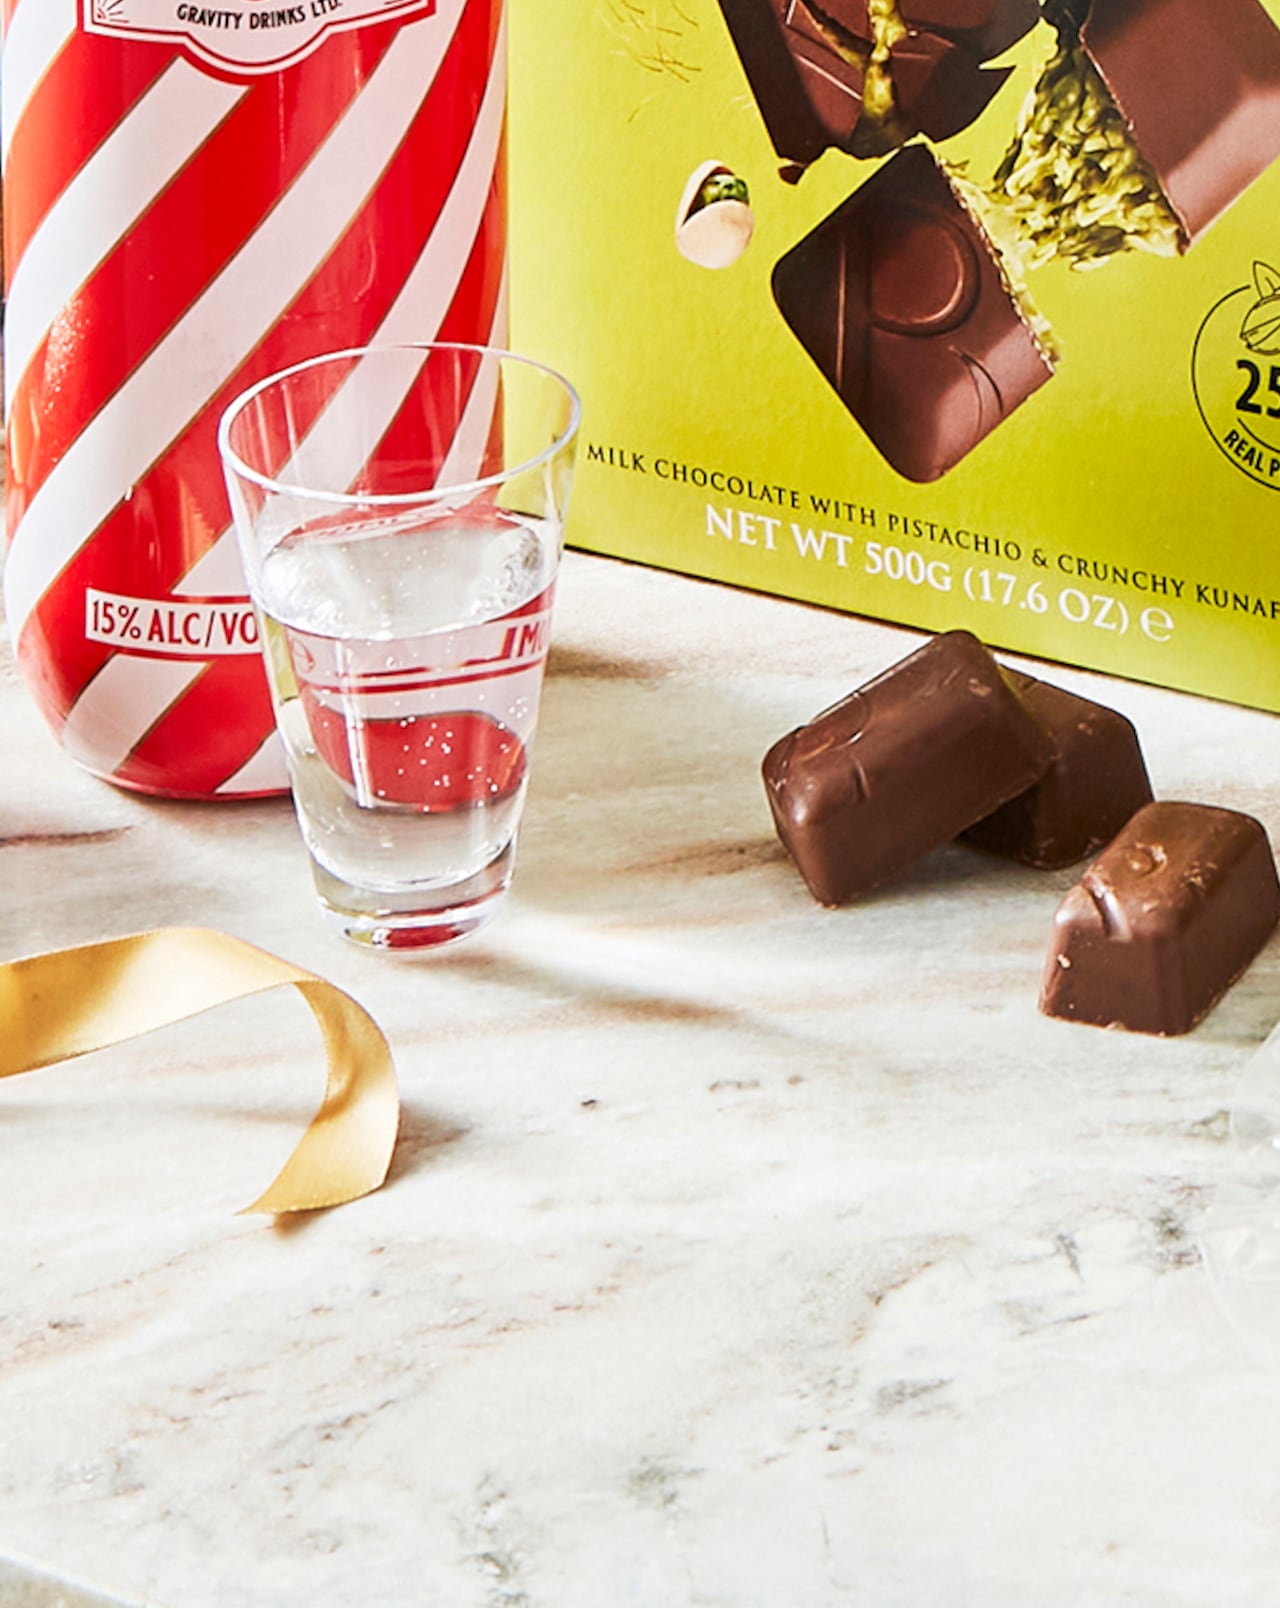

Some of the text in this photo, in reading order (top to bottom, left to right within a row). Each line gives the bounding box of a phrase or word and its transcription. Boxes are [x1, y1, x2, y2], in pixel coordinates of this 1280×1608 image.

[177, 2, 243, 30] GRAVITY
[250, 3, 306, 30] DRINKS
[1223, 429, 1265, 473] REAL
[586, 443, 647, 475] MILK
[653, 457, 802, 510] CHOCOLATE
[809, 494, 878, 528] WITH
[888, 513, 1023, 562] PISTACHIO
[1031, 547, 1050, 569] &
[1057, 553, 1186, 599] CRUNCHY
[705, 502, 782, 551] NET
[790, 522, 854, 568] WT
[864, 541, 953, 592] 500G
[962, 565, 1050, 615] (17.6
[1058, 587, 1131, 636] OZ)
[93, 599, 259, 649] 15% ALC/VO
